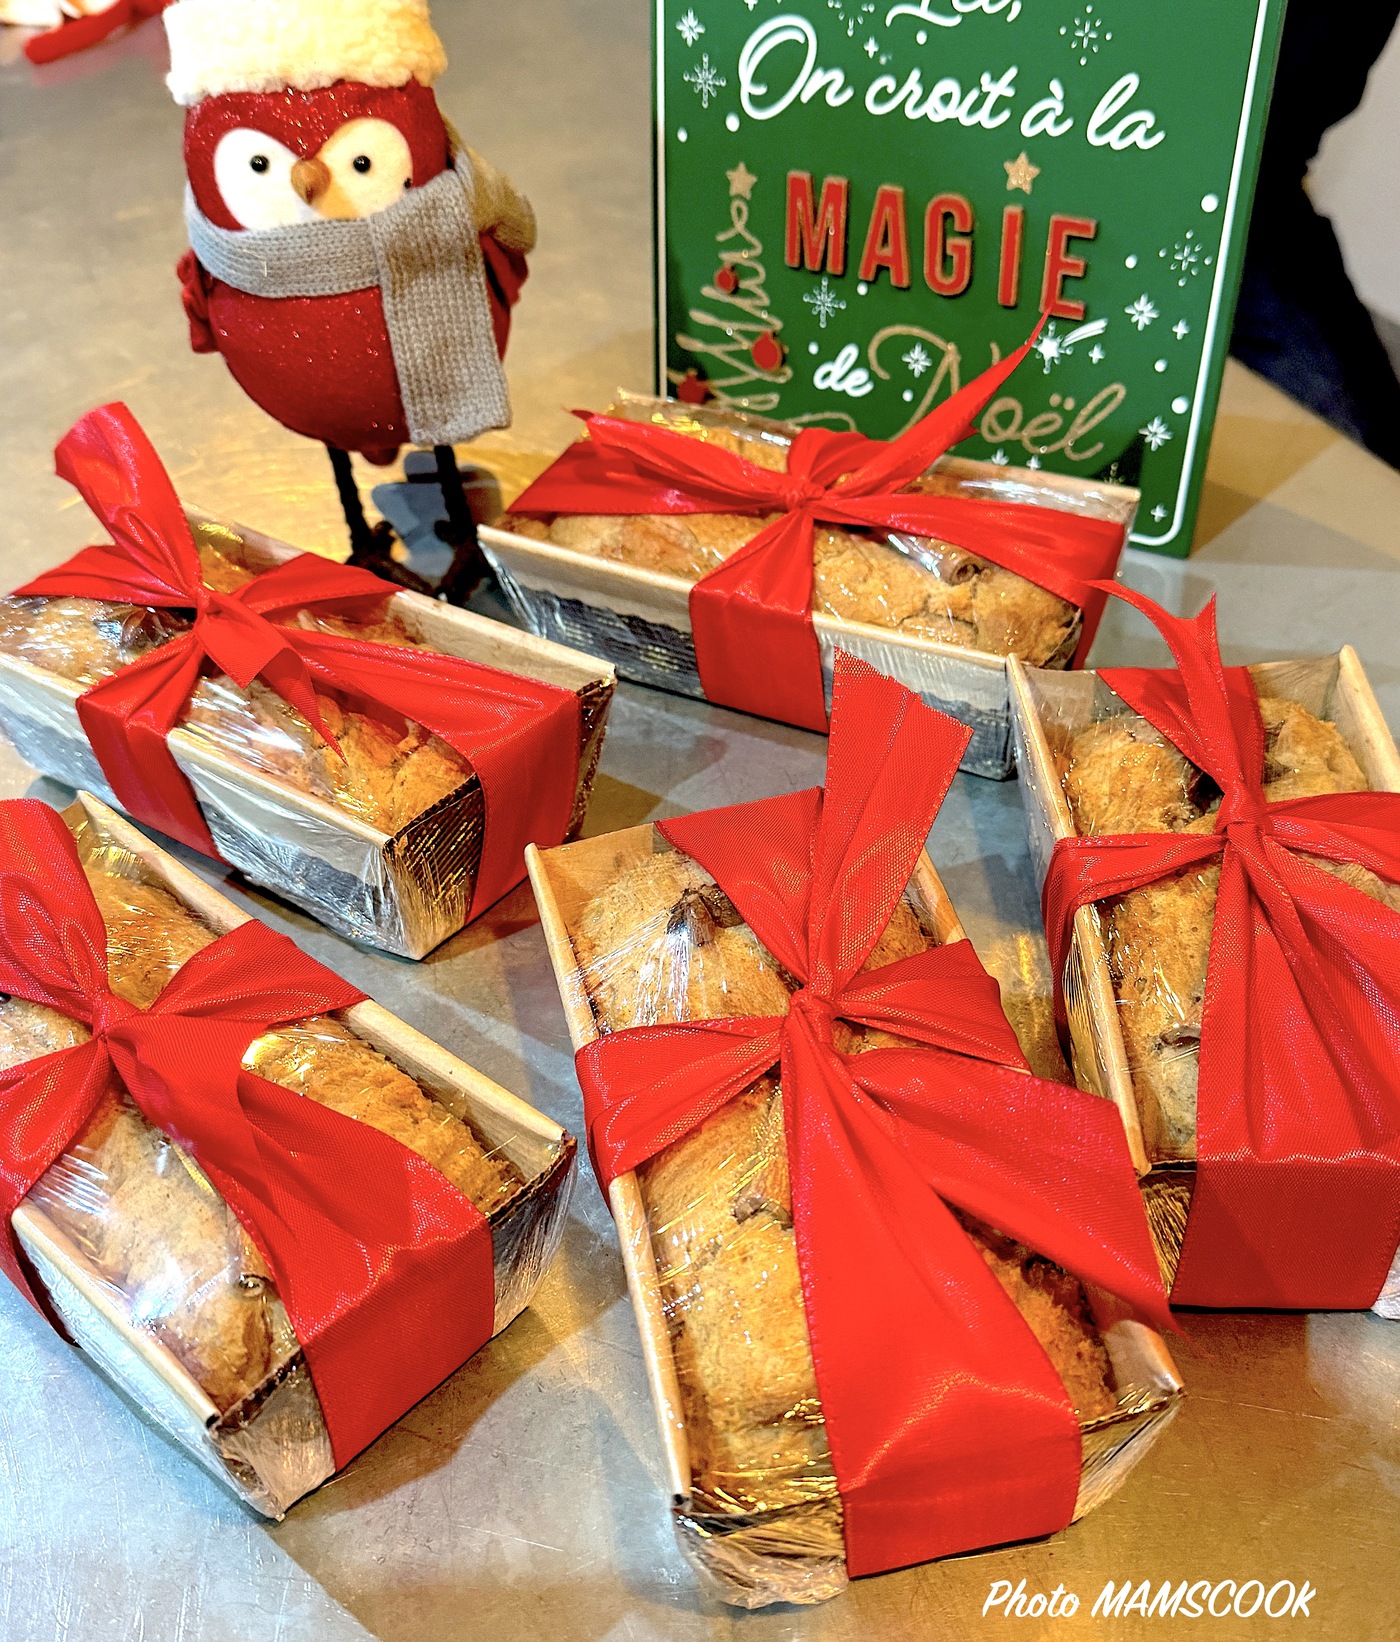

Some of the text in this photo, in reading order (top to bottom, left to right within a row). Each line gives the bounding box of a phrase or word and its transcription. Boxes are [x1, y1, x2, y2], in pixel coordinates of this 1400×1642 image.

[738, 14, 1166, 151] On croit à la
[784, 170, 1098, 321] MAGIE
[812, 343, 875, 397] de
